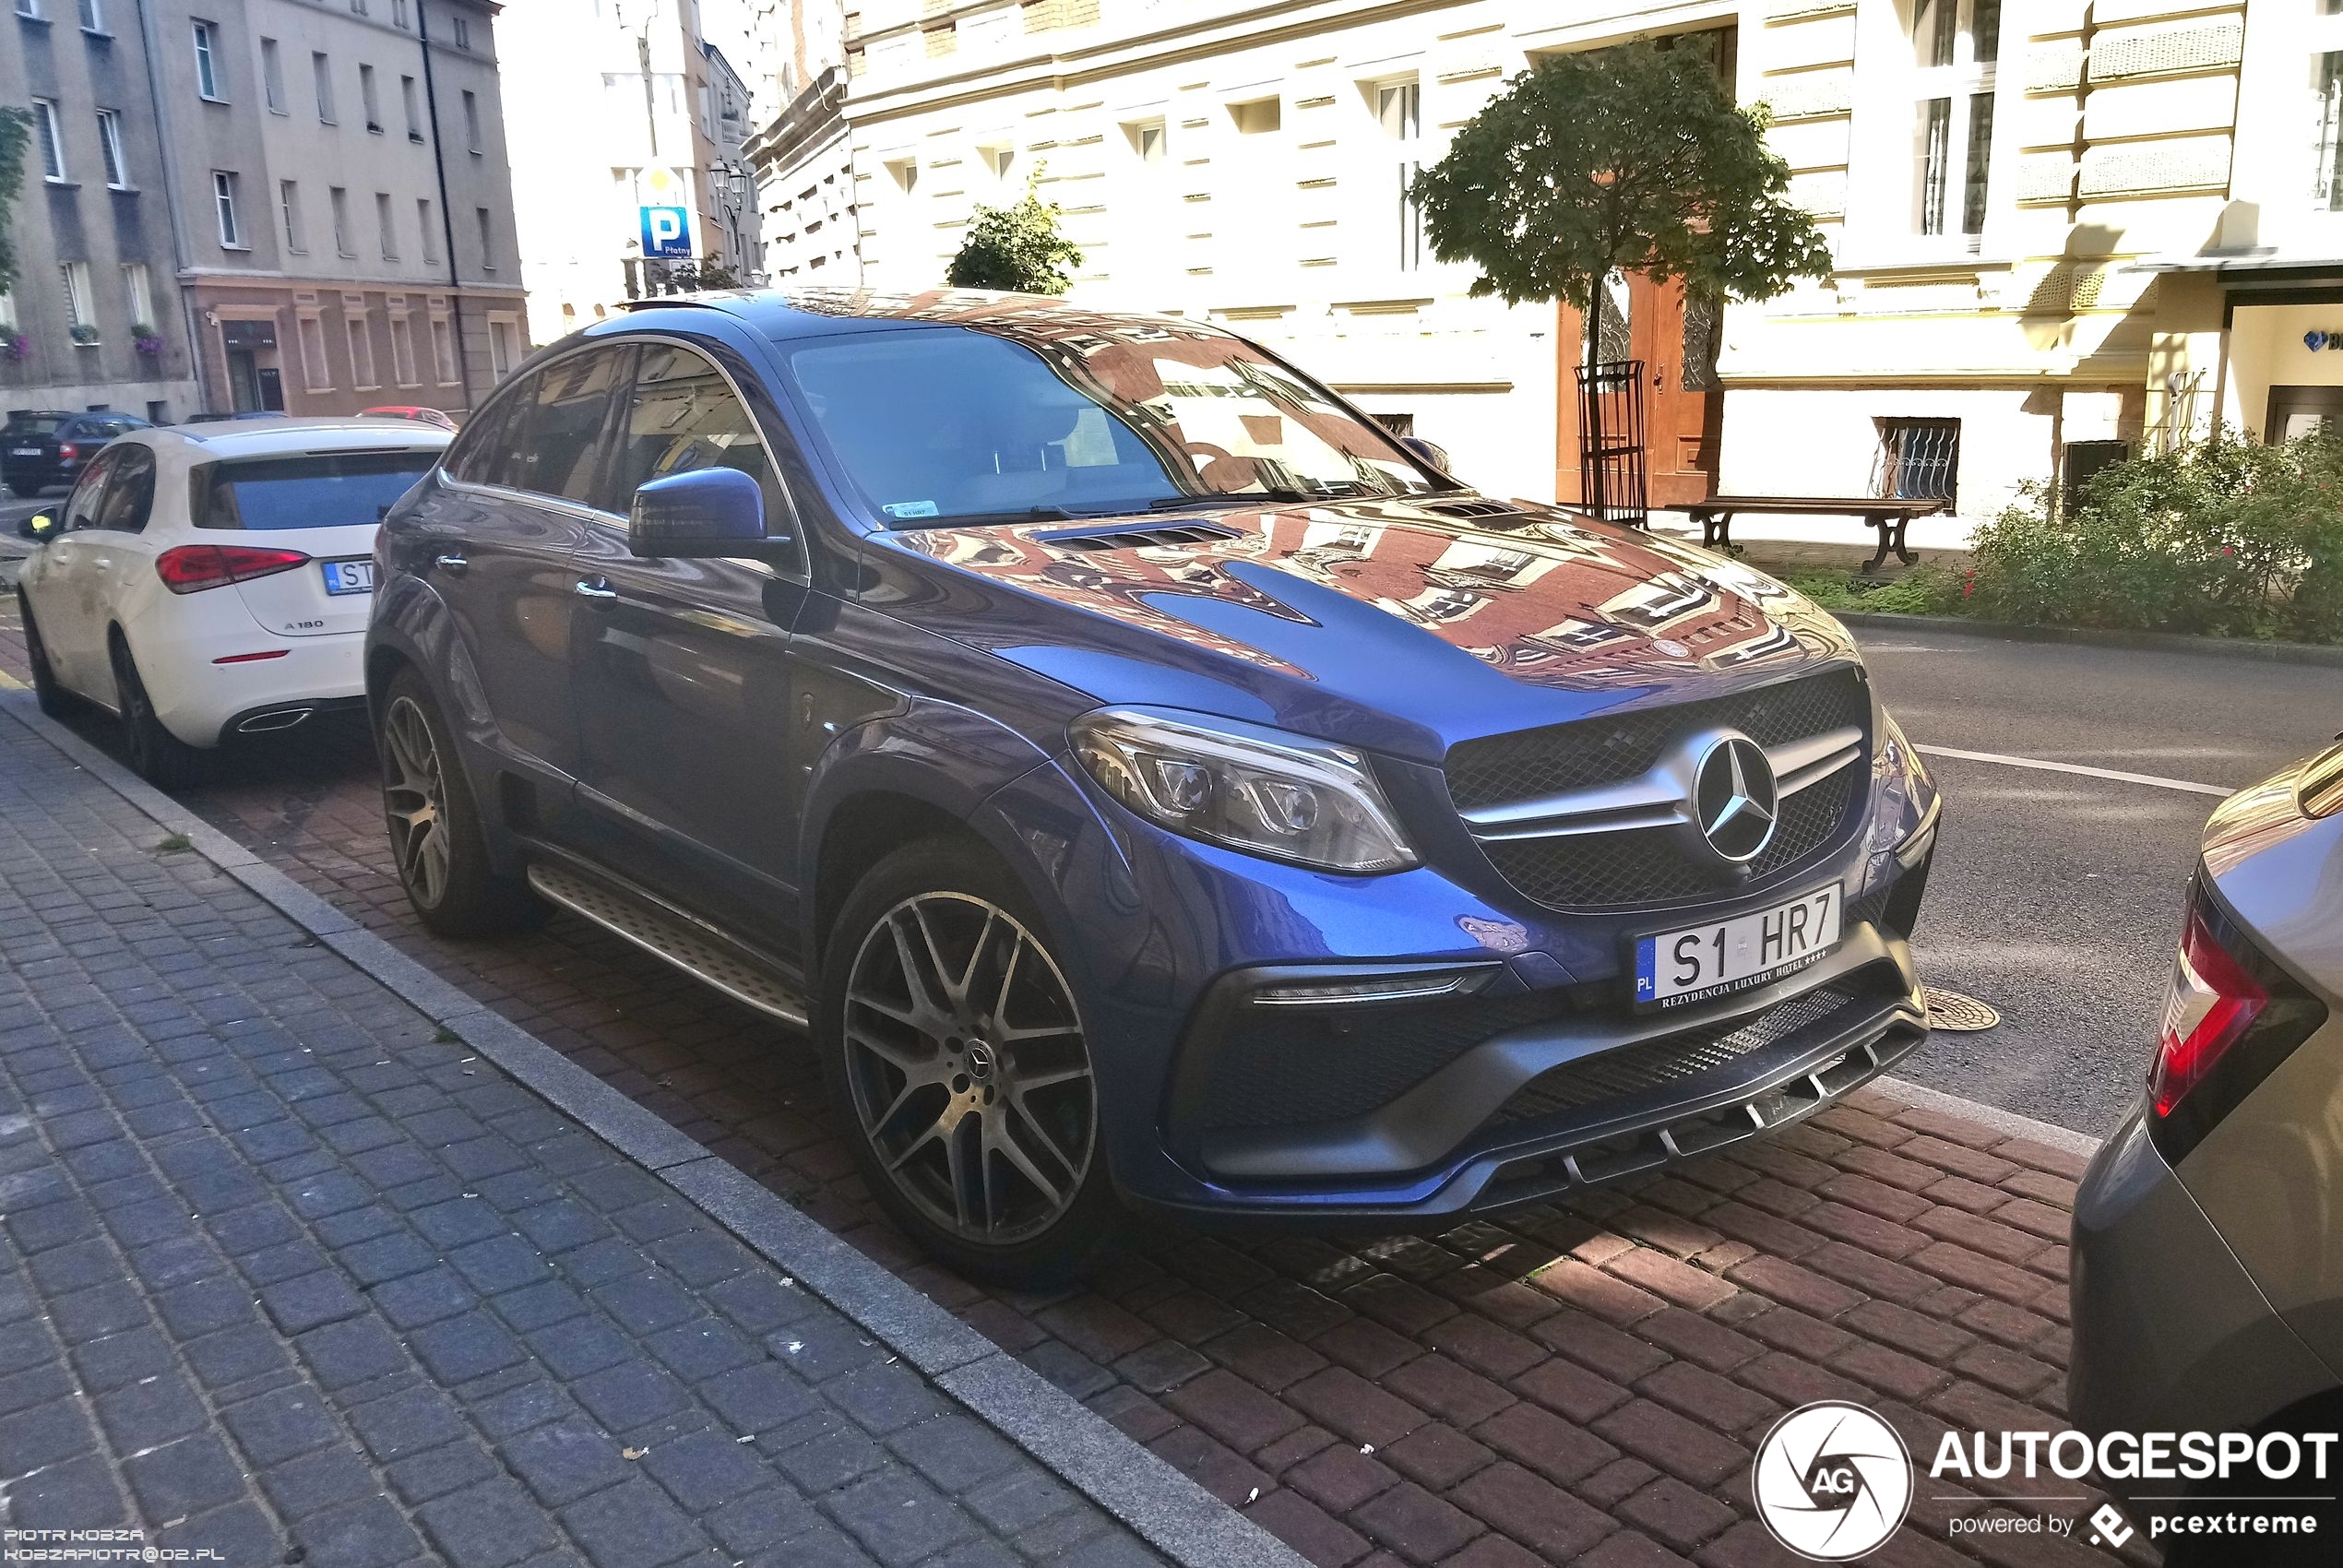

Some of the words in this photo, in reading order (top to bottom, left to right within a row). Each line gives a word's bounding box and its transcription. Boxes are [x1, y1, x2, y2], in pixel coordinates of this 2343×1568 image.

[648, 209, 681, 251] P
[665, 245, 691, 255] Płatny
[297, 620, 324, 629] 180
[1672, 927, 1726, 987] S1
[1760, 892, 1830, 966] HR7
[1637, 977, 1653, 992] PL
[1662, 983, 1730, 1009] REZYDENCJA
[1734, 969, 1773, 991] LUXURY
[1775, 959, 1803, 979] HOTEL
